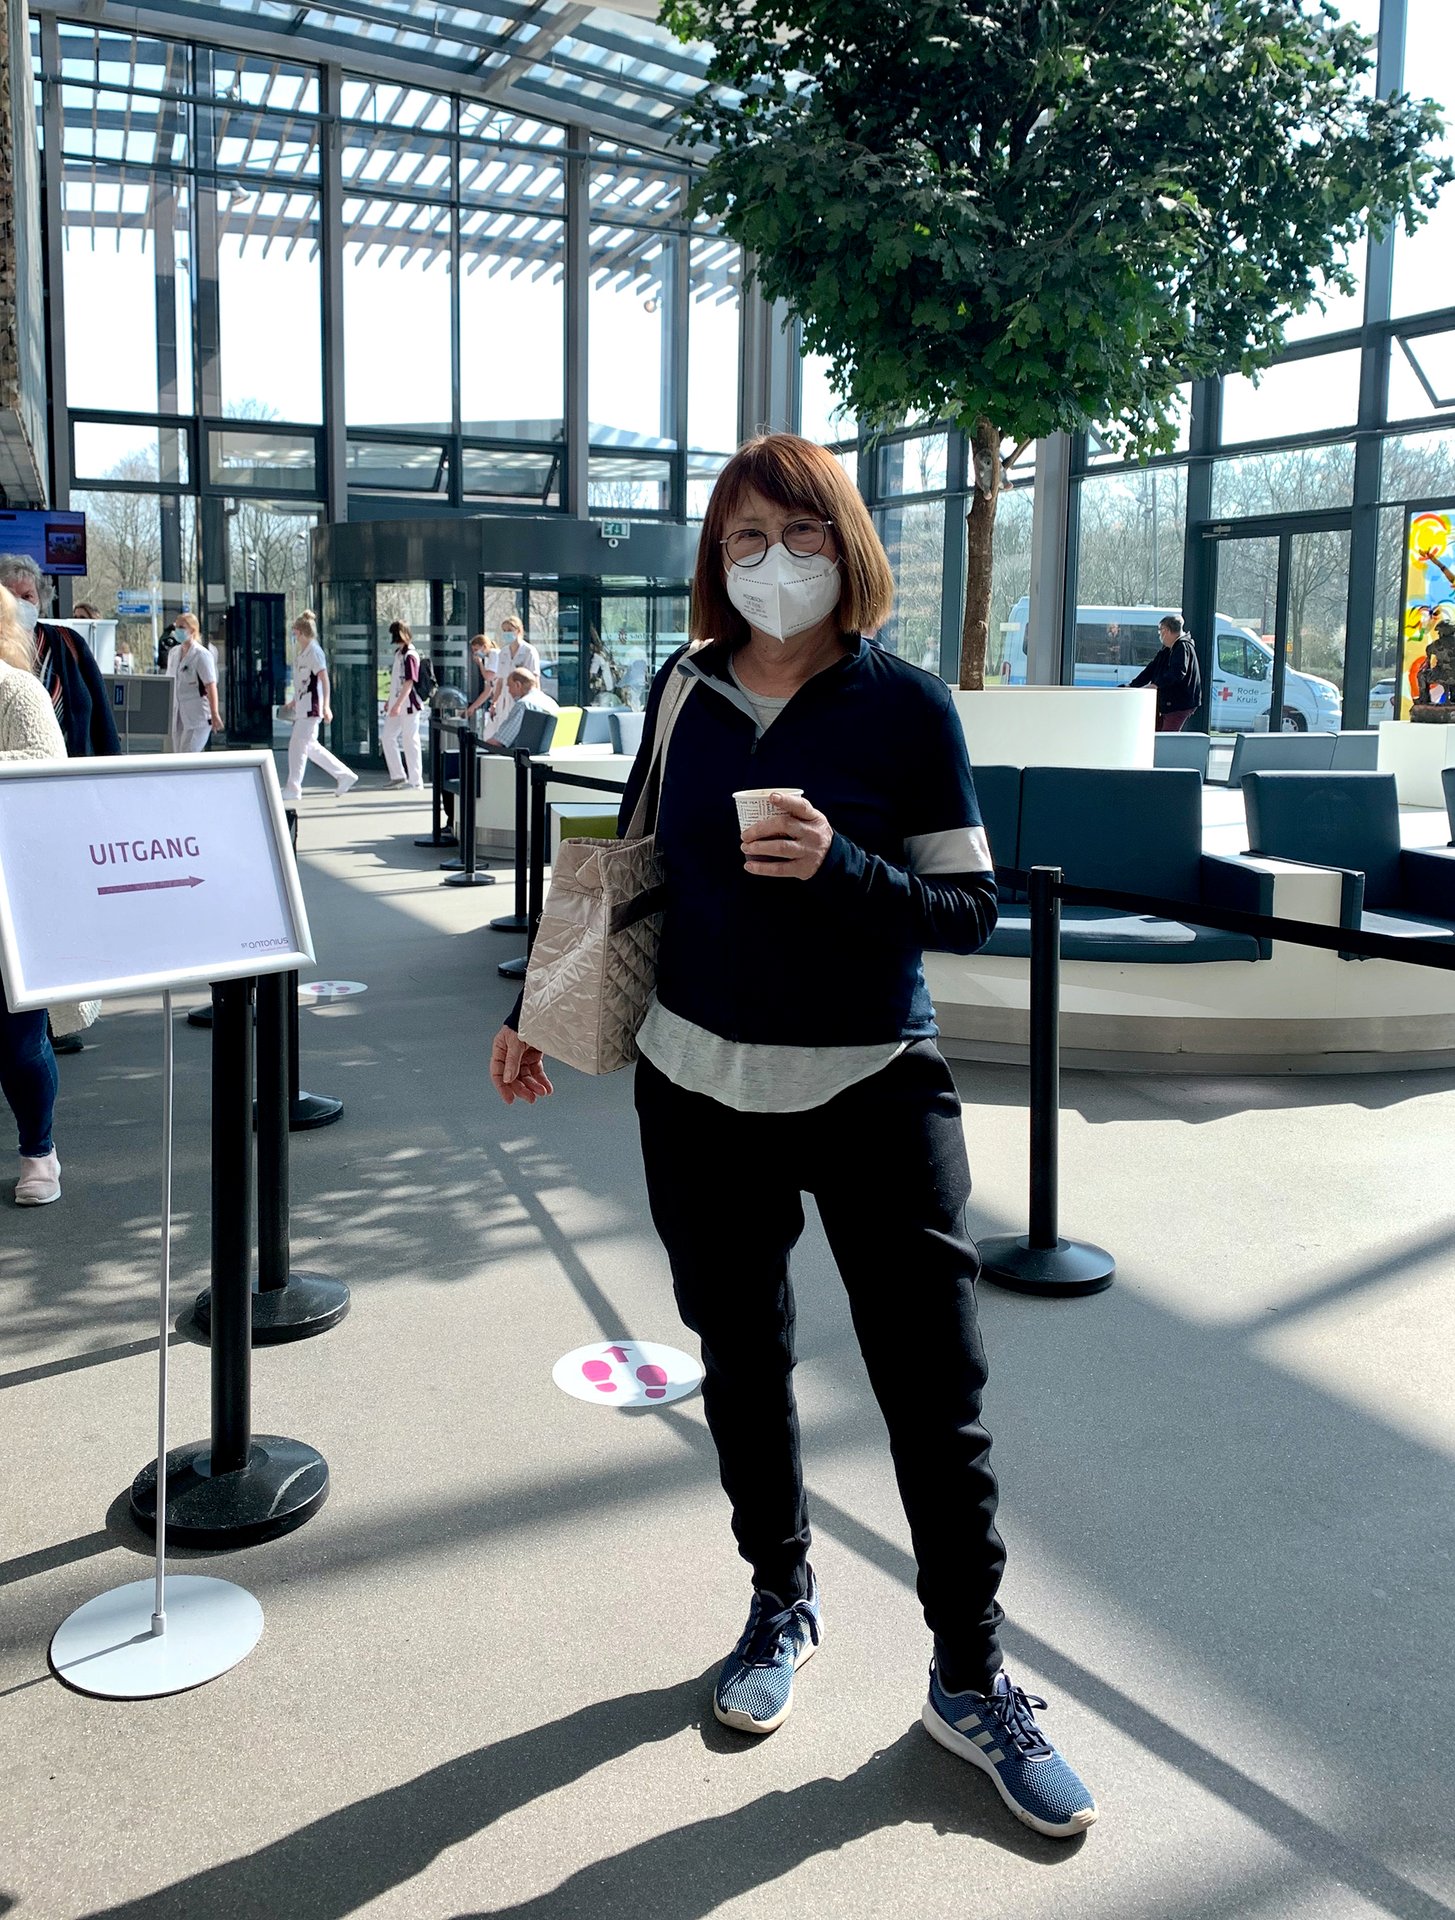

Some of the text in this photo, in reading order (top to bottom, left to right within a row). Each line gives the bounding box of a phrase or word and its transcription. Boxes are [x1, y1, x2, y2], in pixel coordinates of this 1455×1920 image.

[1237, 687, 1259, 695] Rode
[1236, 695, 1258, 703] Kruis
[89, 836, 200, 866] UITGANG
